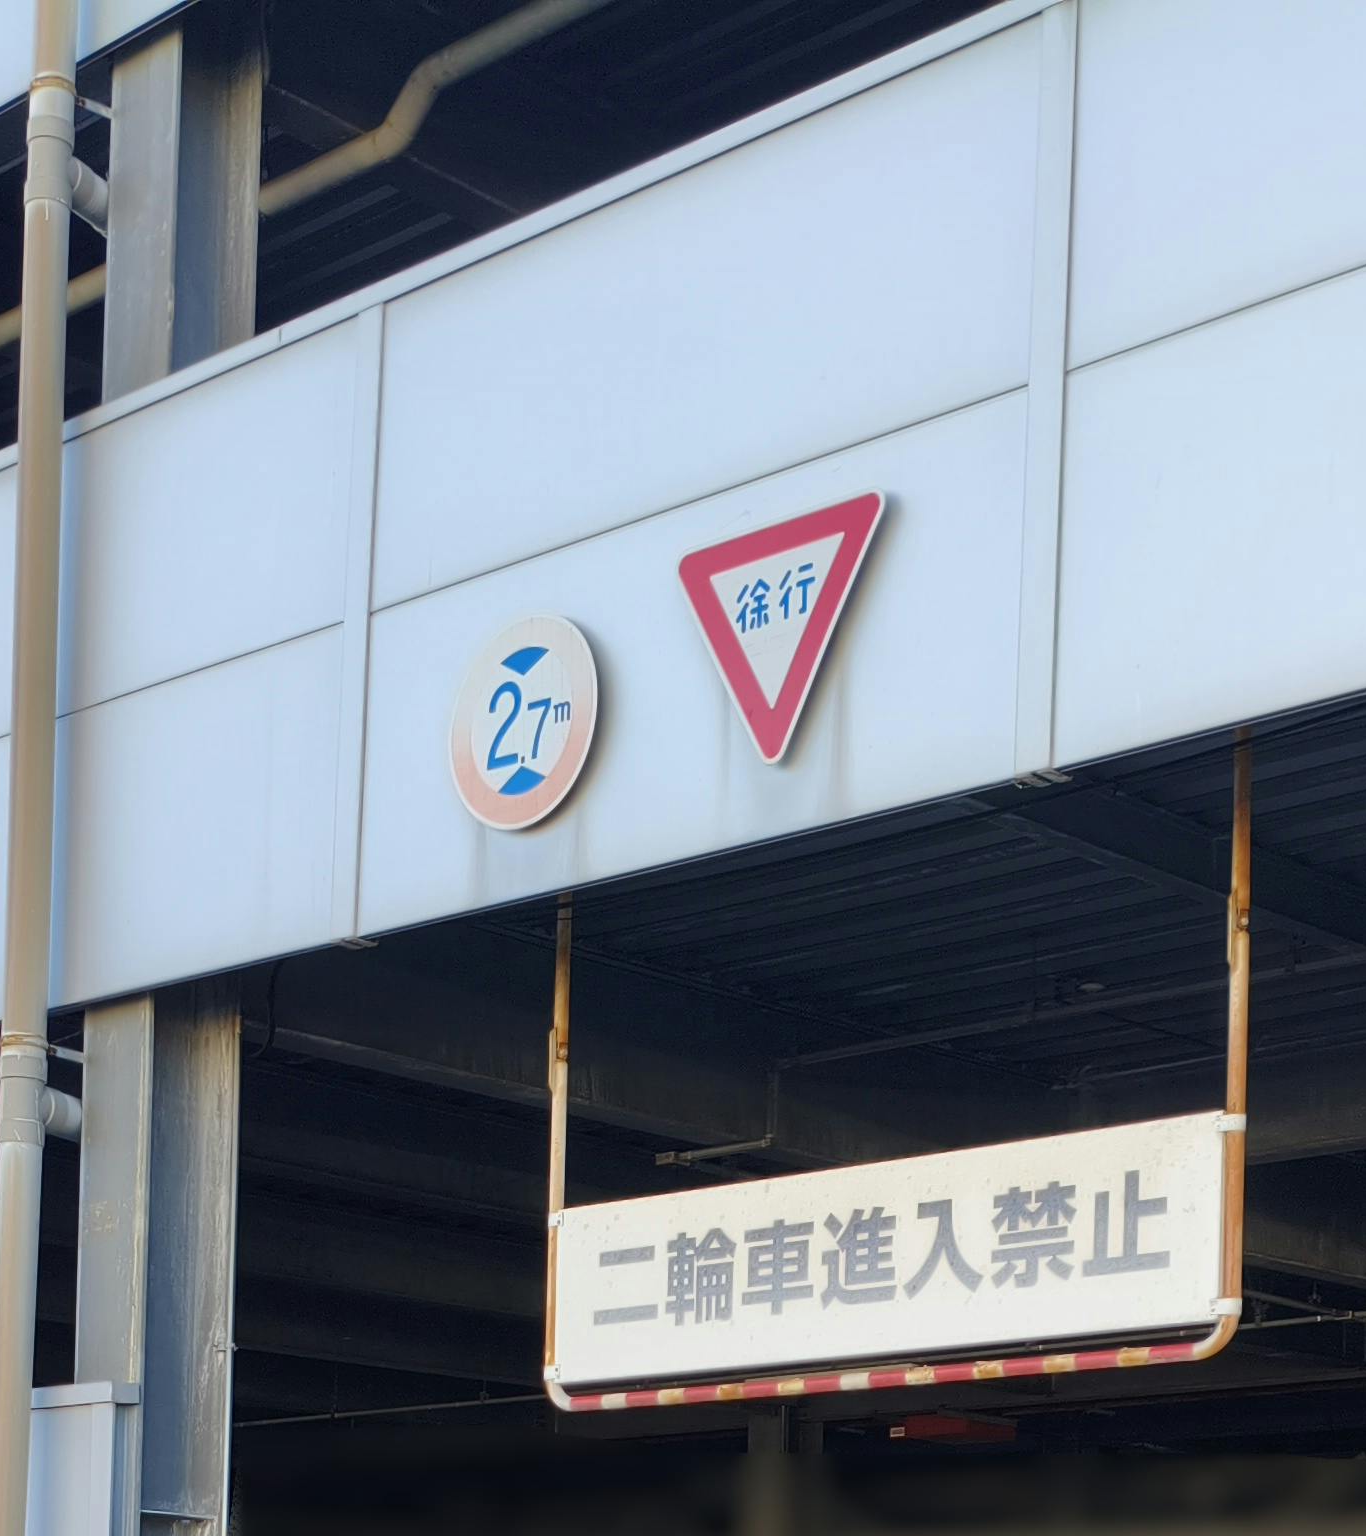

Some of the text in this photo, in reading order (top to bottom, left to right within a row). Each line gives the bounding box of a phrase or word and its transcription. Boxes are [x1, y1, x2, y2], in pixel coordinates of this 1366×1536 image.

[736, 562, 816, 634] 徐行
[592, 1170, 1171, 1327] 二輪車進入禁止
